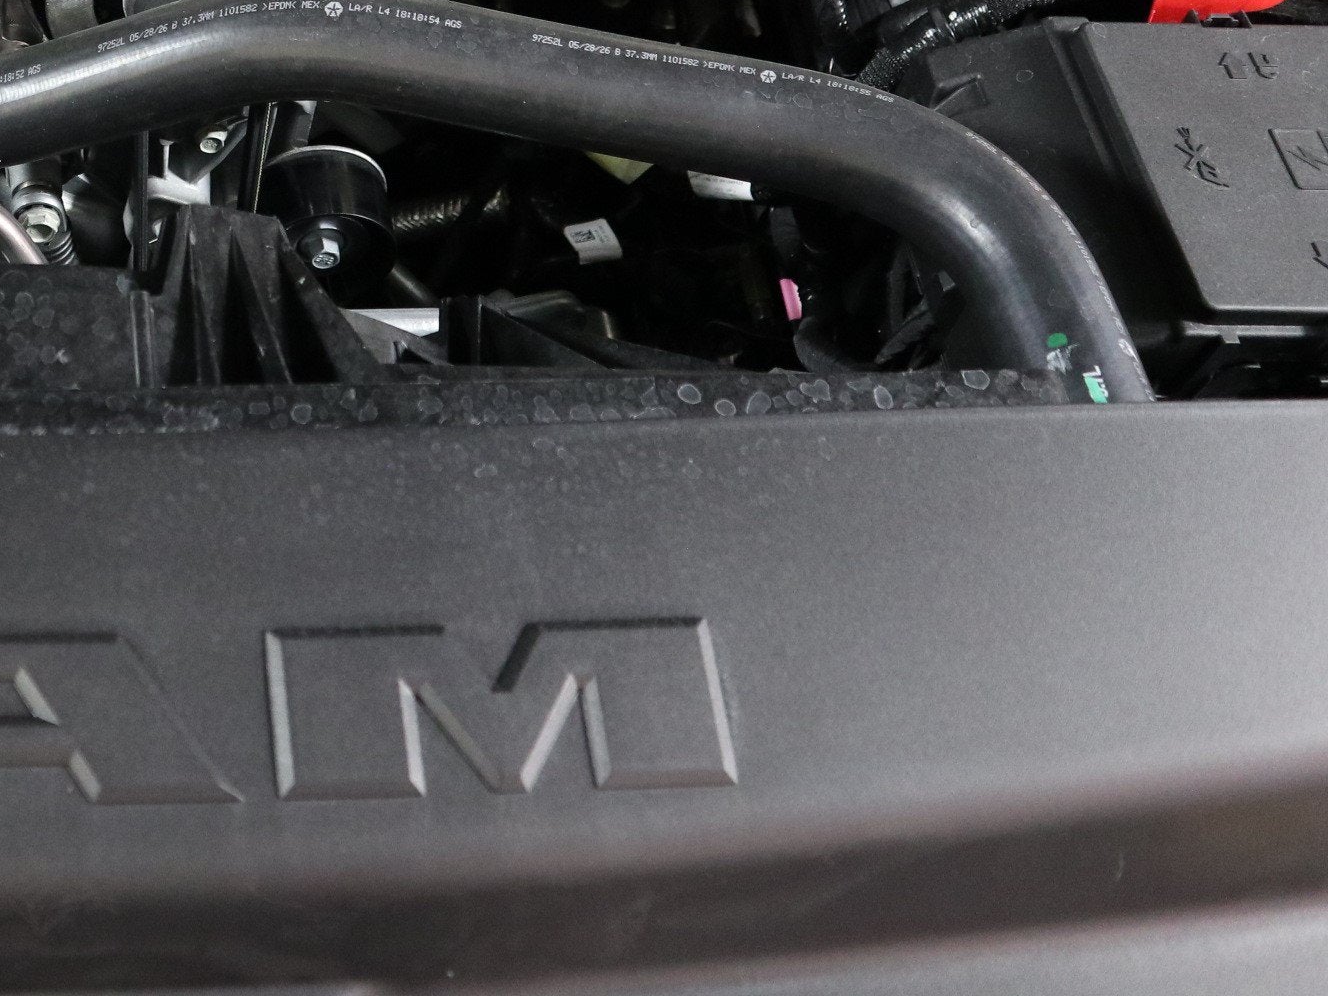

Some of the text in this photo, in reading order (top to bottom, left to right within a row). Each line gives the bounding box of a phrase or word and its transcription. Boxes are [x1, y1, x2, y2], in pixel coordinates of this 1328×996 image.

[219, 3, 258, 18] 1101582
[301, 0, 321, 10] MEX
[348, 3, 374, 14] LA/R
[378, 6, 391, 16] L4
[444, 19, 463, 29] AGS
[27, 64, 42, 78] AGS
[531, 33, 564, 47] 97252L
[625, 49, 658, 62] 37.3MM
[662, 54, 700, 67] 1101582
[739, 65, 757, 76] MEX
[809, 76, 822, 85] L4
[876, 93, 895, 103] AGS
